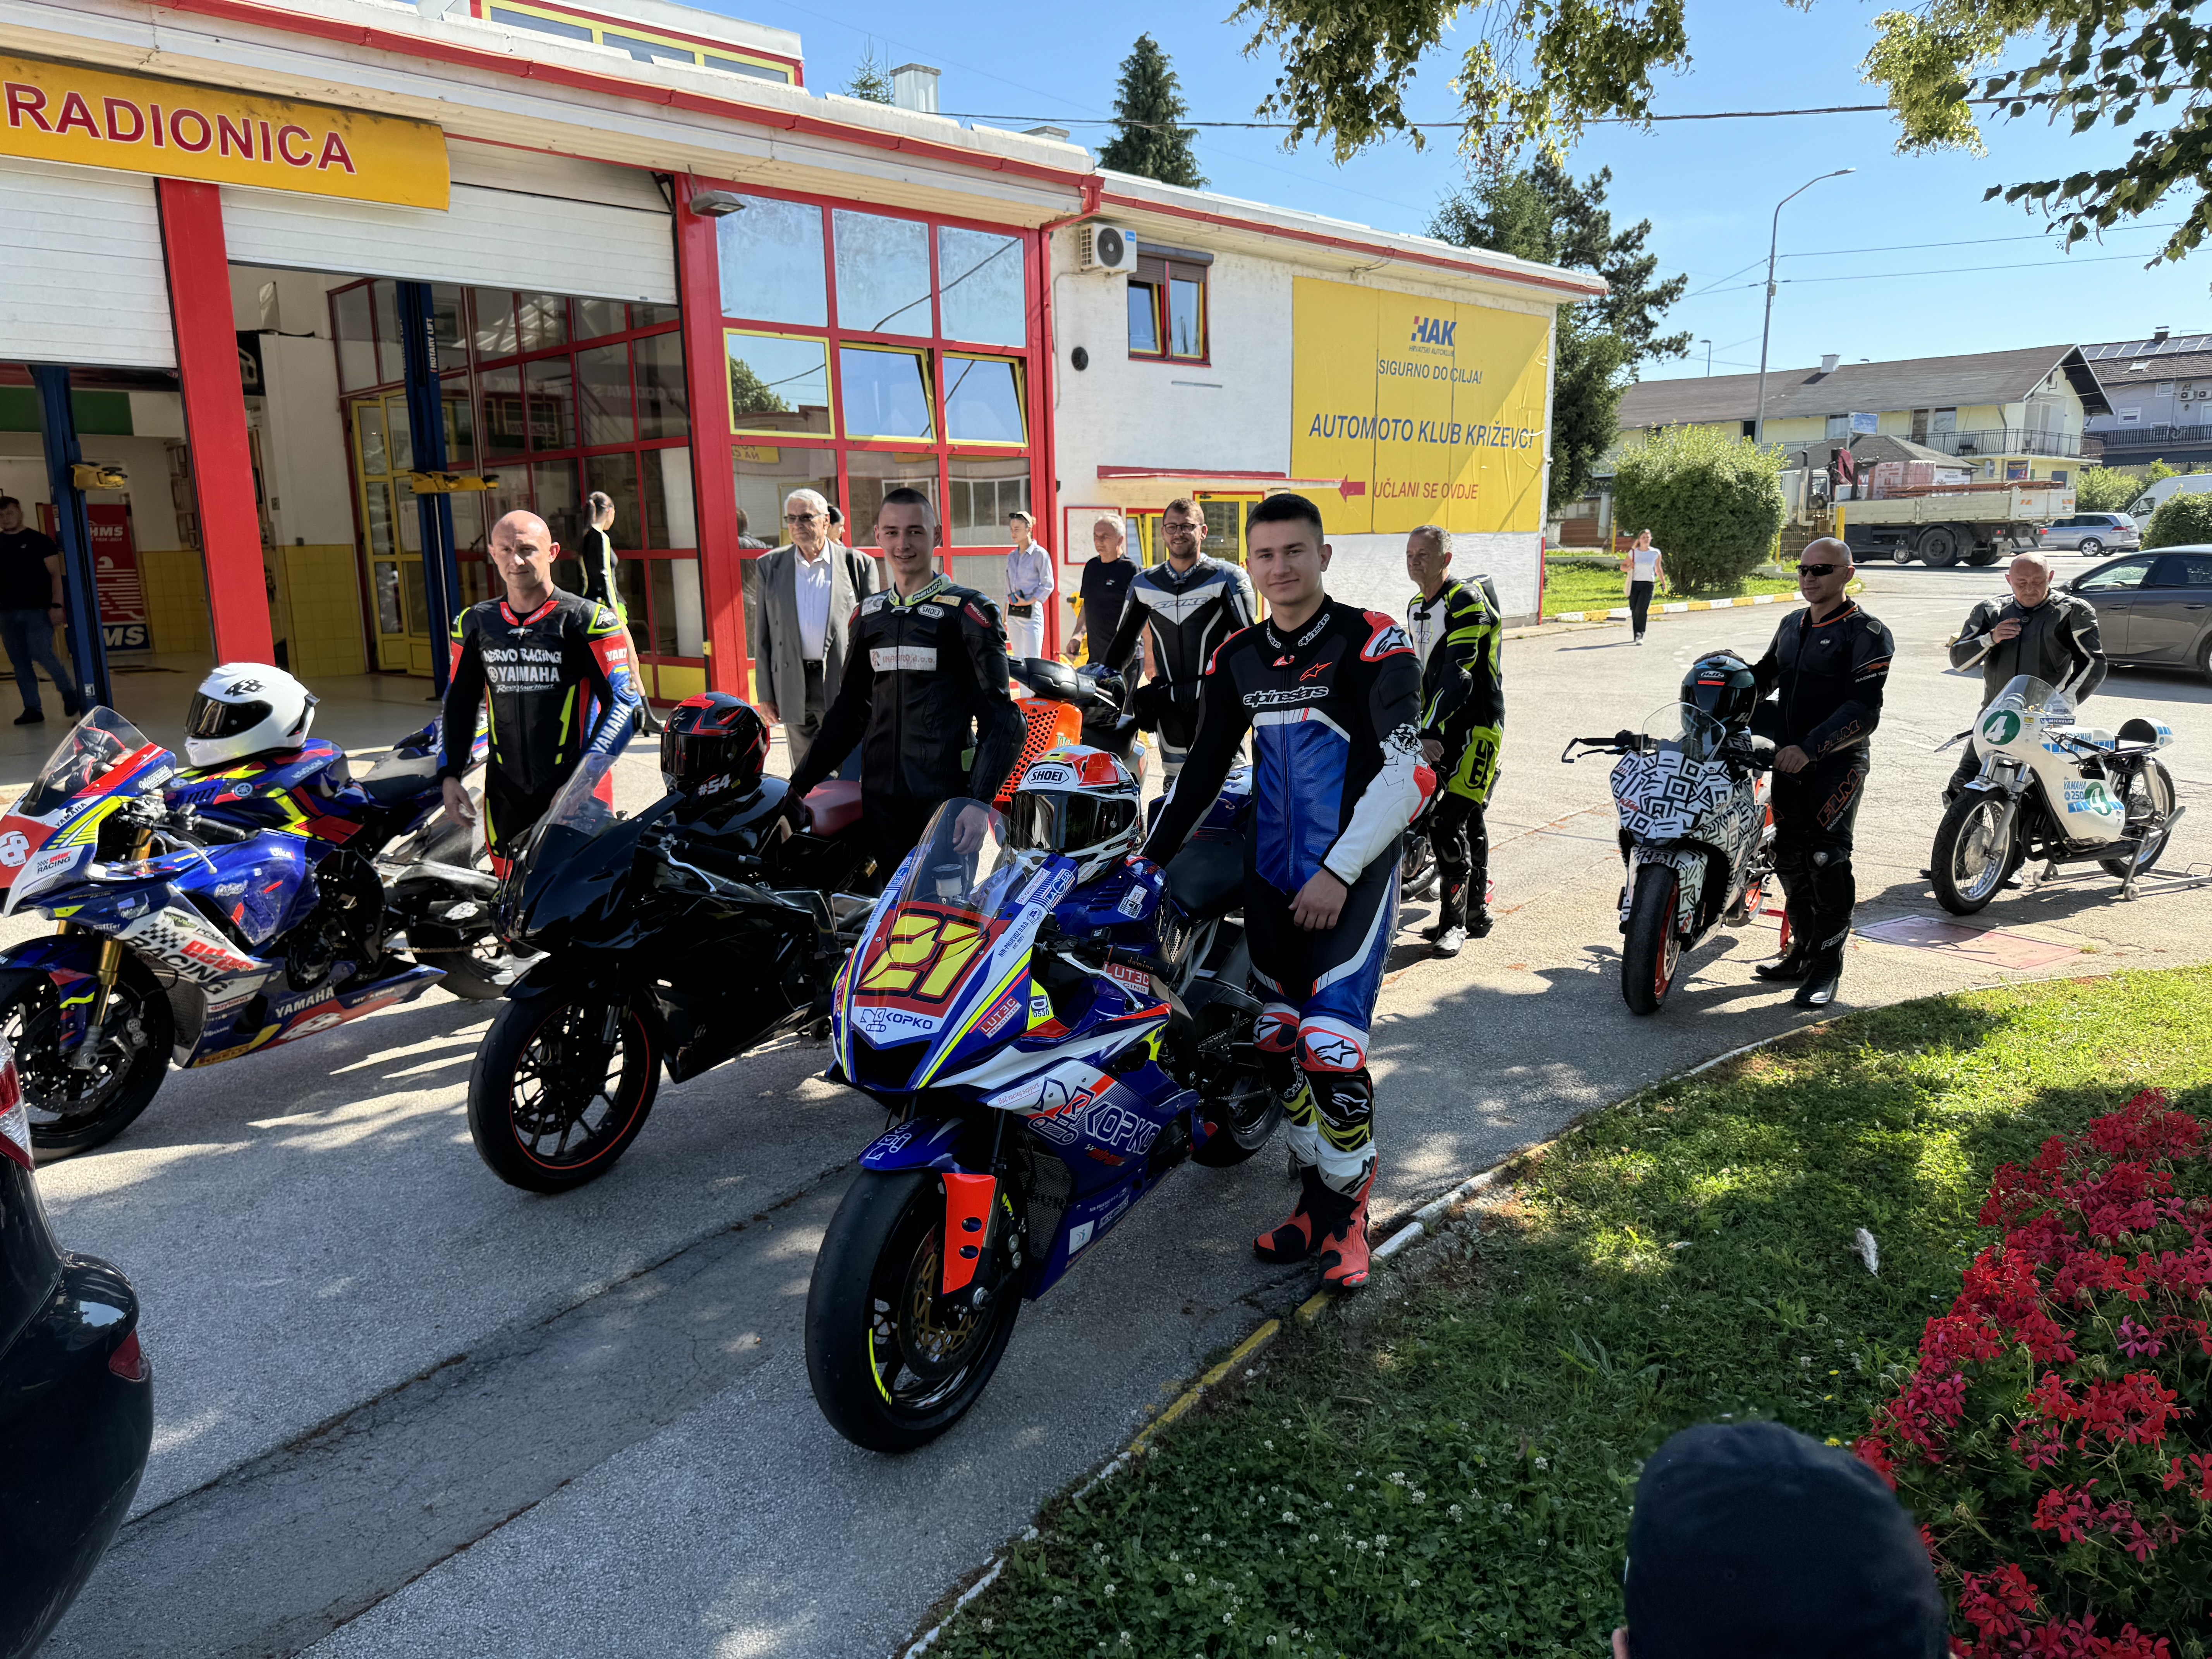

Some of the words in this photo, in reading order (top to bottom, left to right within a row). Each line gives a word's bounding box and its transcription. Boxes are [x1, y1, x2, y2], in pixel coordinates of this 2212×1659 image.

[4, 81, 357, 174] RADIONICA
[426, 318, 434, 335] LIFT
[1411, 316, 1457, 347] HAK
[428, 336, 437, 368] ROTARY
[1409, 345, 1430, 354] HRVATSKI
[1378, 359, 1430, 379] SIGURNO
[1433, 365, 1448, 381] DO
[1450, 368, 1483, 384] CILJA!
[1309, 414, 1413, 442] AUTOMOTO
[1418, 420, 1461, 444] KLUB
[1374, 478, 1420, 498] UČLANI
[1423, 483, 1437, 498] SE
[1441, 483, 1478, 500] OVDJE
[922, 606, 940, 616] SHOEI
[483, 648, 518, 663] NERVO
[498, 666, 560, 682] YAMAHA
[1855, 673, 1877, 683] RACING
[590, 703, 632, 754] YAMAHA
[1817, 720, 1860, 753] FLM
[1984, 716, 2008, 742] 4
[1031, 771, 1063, 782] SHOEI
[1617, 766, 1629, 775] 911
[698, 773, 731, 796] #54
[2064, 781, 2087, 790] YAMAHA
[2071, 791, 2084, 800] 250
[1618, 798, 1640, 811] KTM
[1816, 768, 1860, 827] FLM
[2090, 787, 2107, 814] 4
[55, 802, 87, 827] YAMAHA
[1826, 811, 1844, 831] RACING
[37, 856, 71, 874] RACING
[1034, 870, 1047, 885] support
[1046, 872, 1072, 903] LAGER
[1820, 926, 1848, 950] RST
[1127, 957, 1154, 971] domino
[275, 986, 335, 1018] YAMAHA
[885, 1012, 933, 1030] KOPKO
[991, 1007, 1018, 1034] RACING
[1033, 1009, 1050, 1018] 0530
[998, 1096, 1008, 1105] Bač
[1008, 1090, 1022, 1102] racing
[1022, 1082, 1039, 1096] support
[1085, 1101, 1161, 1156] KOPKO
